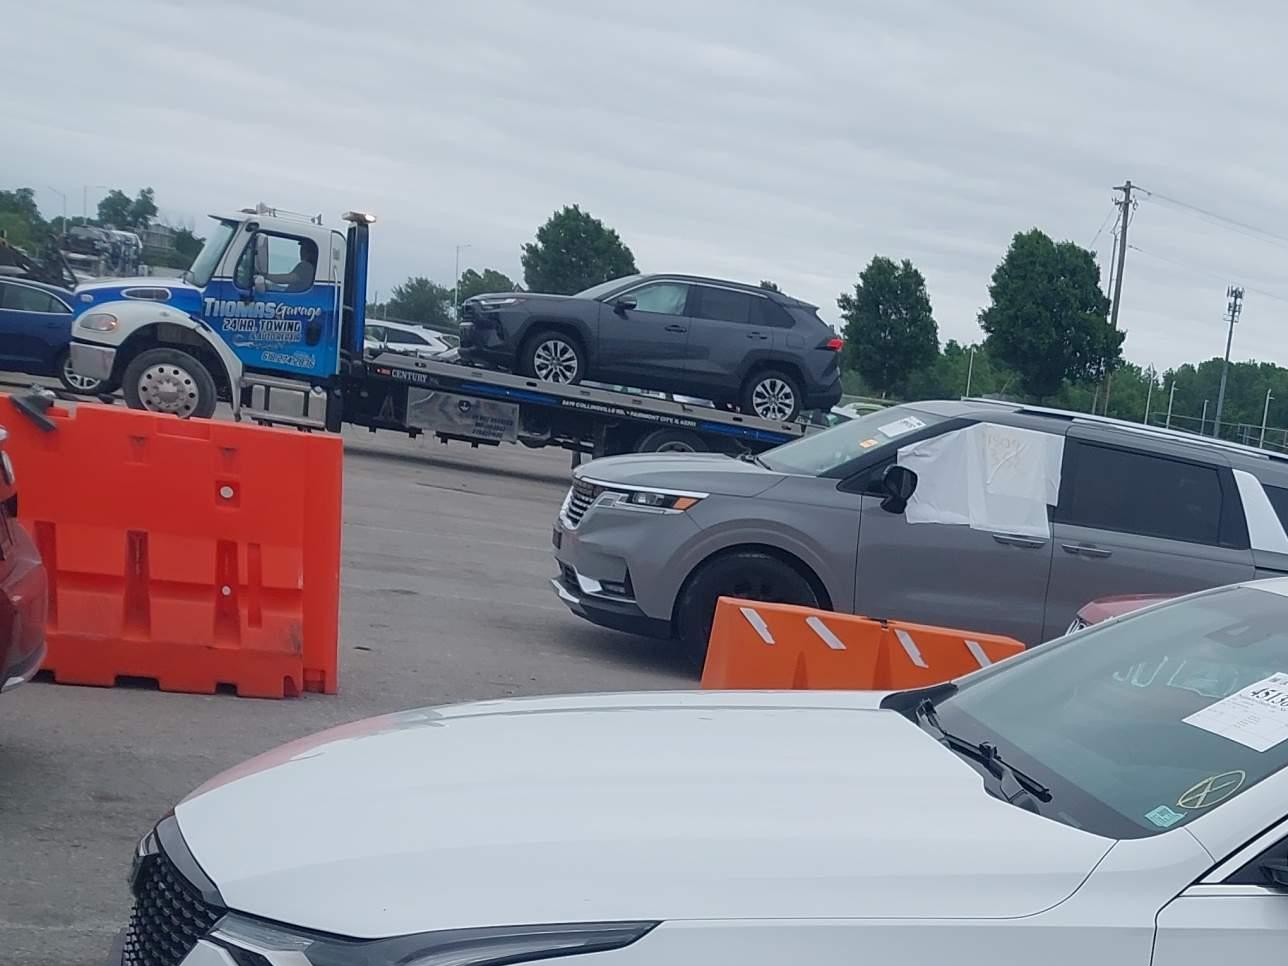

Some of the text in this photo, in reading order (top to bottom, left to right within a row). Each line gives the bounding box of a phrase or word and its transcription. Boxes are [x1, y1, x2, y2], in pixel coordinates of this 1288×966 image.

[204, 298, 321, 322] THOMAS Garage
[223, 318, 238, 331] 24
[258, 319, 302, 333] TOWING
[391, 369, 428, 382] CENTURY
[576, 401, 615, 413] COLLINSVILLE
